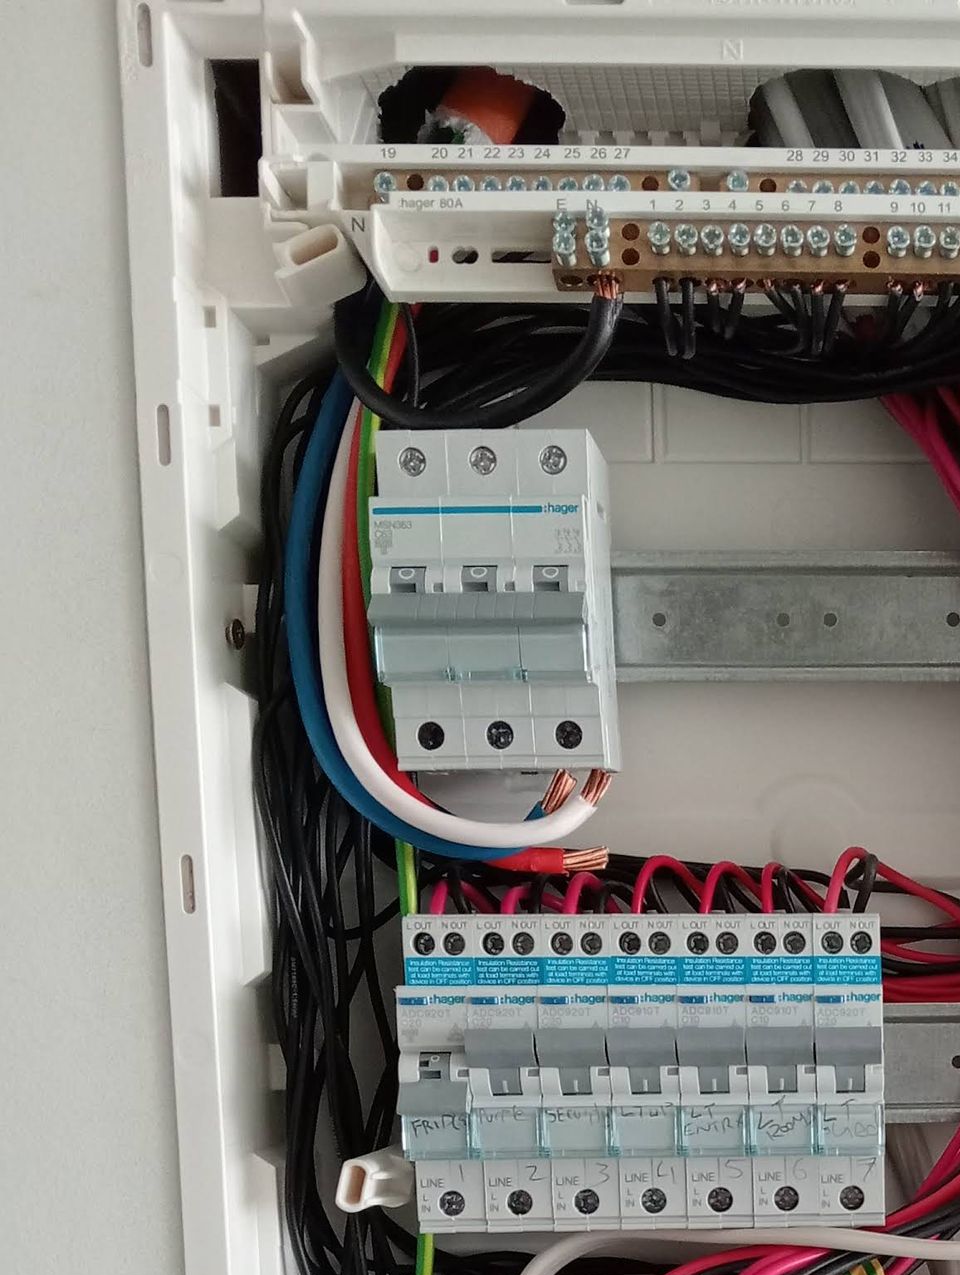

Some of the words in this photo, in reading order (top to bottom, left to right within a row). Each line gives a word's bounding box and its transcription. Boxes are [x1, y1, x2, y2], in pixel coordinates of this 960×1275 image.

[381, 147, 396, 158] 19
[432, 147, 448, 159] 20
[458, 147, 472, 159] 21
[484, 147, 500, 159] 22
[508, 147, 524, 159] 23
[534, 148, 550, 159] 24
[564, 148, 580, 159] 25
[591, 148, 606, 159] 26
[614, 148, 630, 159] 27
[787, 150, 803, 161] 28
[813, 151, 829, 162] 29
[839, 151, 855, 162] 30
[864, 149, 878, 162] 31
[892, 151, 906, 162] 32
[919, 152, 932, 162] 33
[943, 152, 958, 162] 34
[440, 198, 463, 208] 80A
[557, 199, 566, 210] E
[649, 200, 656, 213] 1
[675, 200, 683, 211] 2
[702, 199, 710, 210] 3
[728, 200, 736, 210] 4
[756, 200, 763, 211] 5
[782, 200, 789, 212] 6
[808, 200, 816, 211] 7
[834, 201, 842, 212] 8
[890, 202, 898, 213] 9
[911, 202, 925, 215] 10
[938, 202, 950, 213] 11
[352, 217, 365, 232] N
[484, 921, 501, 929] OUT
[520, 921, 538, 929] OUT
[553, 922, 570, 930] OUT
[589, 922, 605, 930] OUT
[621, 921, 639, 929] OUT
[658, 921, 672, 929] OUT
[690, 921, 708, 929] OUT
[724, 921, 740, 929] OUT
[758, 921, 775, 929] OUT
[793, 921, 809, 929] OUT
[823, 921, 840, 929] OUT
[858, 921, 874, 929] OUT
[526, 1165, 546, 1180] 2
[857, 1157, 877, 1180] 7
[556, 1176, 578, 1186] LINE
[624, 1174, 648, 1183] LINE
[692, 1172, 715, 1182] LINE
[759, 1172, 781, 1181] LINE
[821, 1174, 844, 1183] LINE
[420, 1178, 444, 1188] LINE
[489, 1177, 512, 1186] LINE
